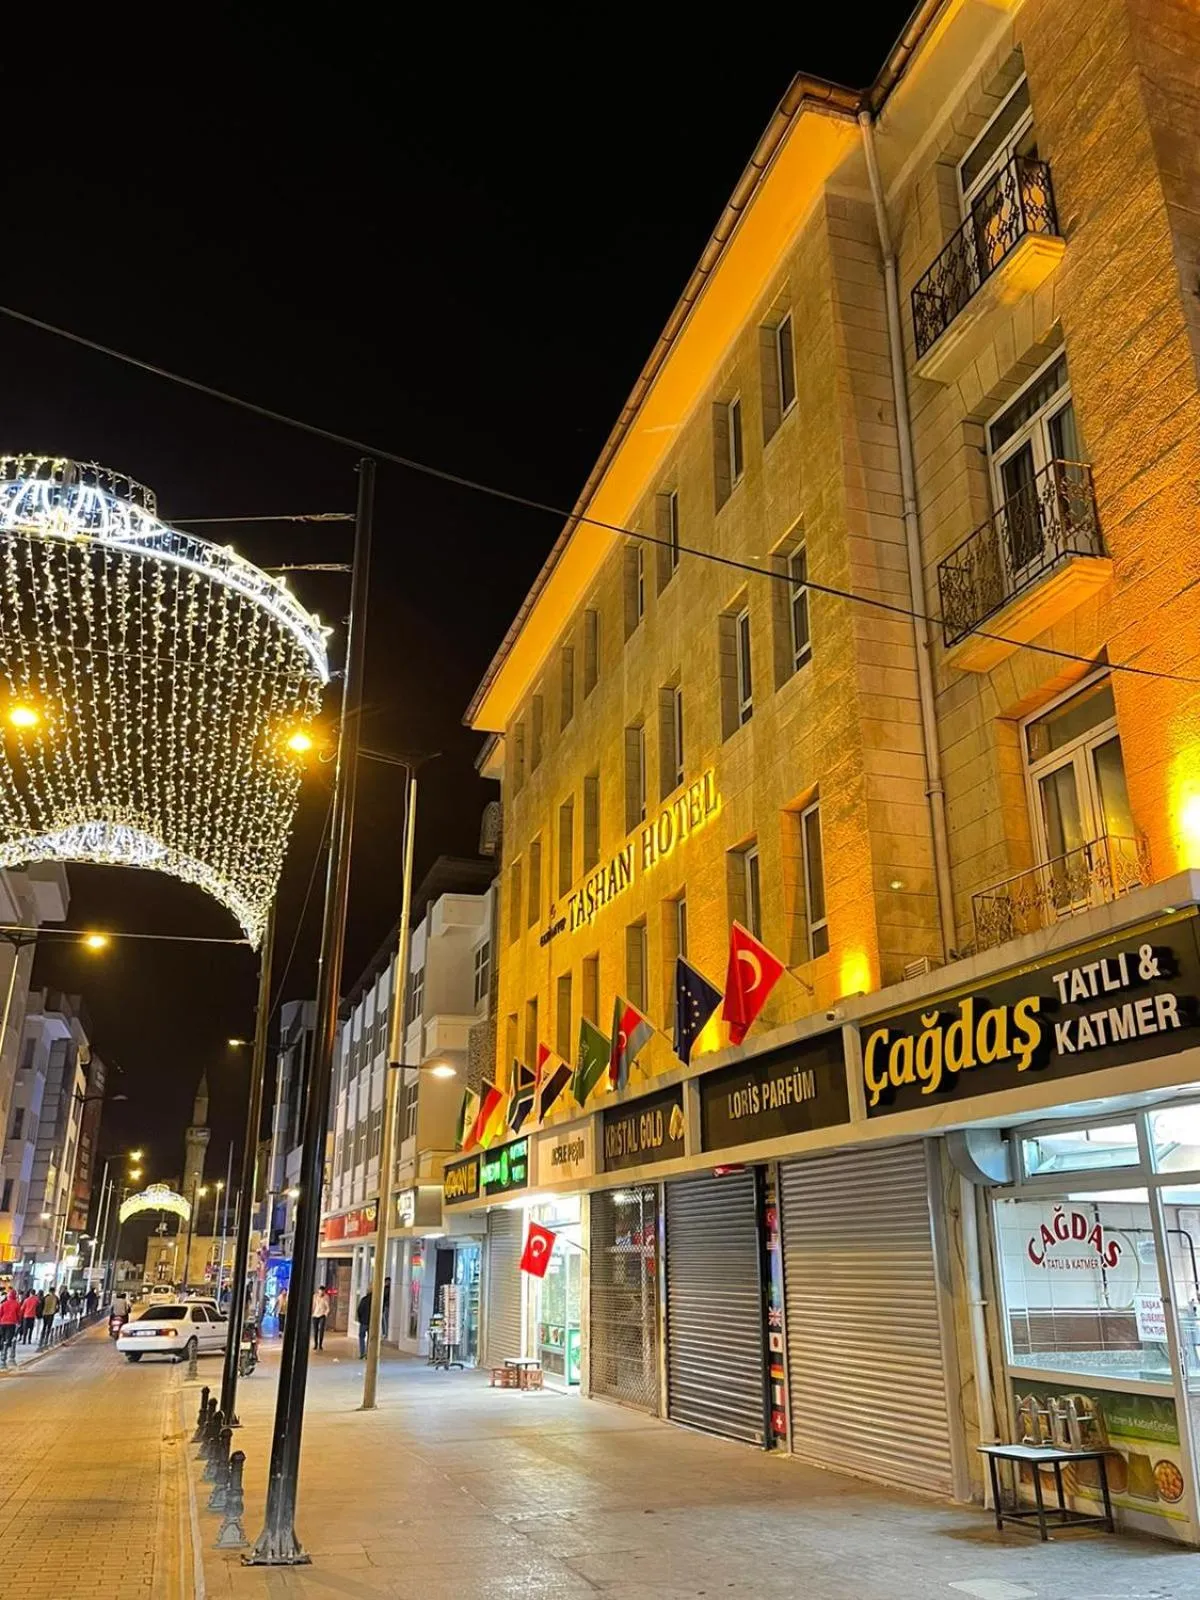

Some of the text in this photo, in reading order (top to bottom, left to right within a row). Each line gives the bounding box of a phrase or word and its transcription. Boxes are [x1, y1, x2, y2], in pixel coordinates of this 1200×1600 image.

[568, 768, 721, 934] TAŞHAN HOTEL
[1053, 943, 1161, 1004] TATLI &
[864, 996, 1042, 1107] Çağdaş
[1055, 993, 1182, 1056] KATMER
[728, 1066, 817, 1120] LORİS PARFÜM
[640, 1110, 663, 1150] GOLD
[1027, 1205, 1123, 1269] ÇAĞDAŞ
[1072, 1258, 1099, 1269] KATMER
